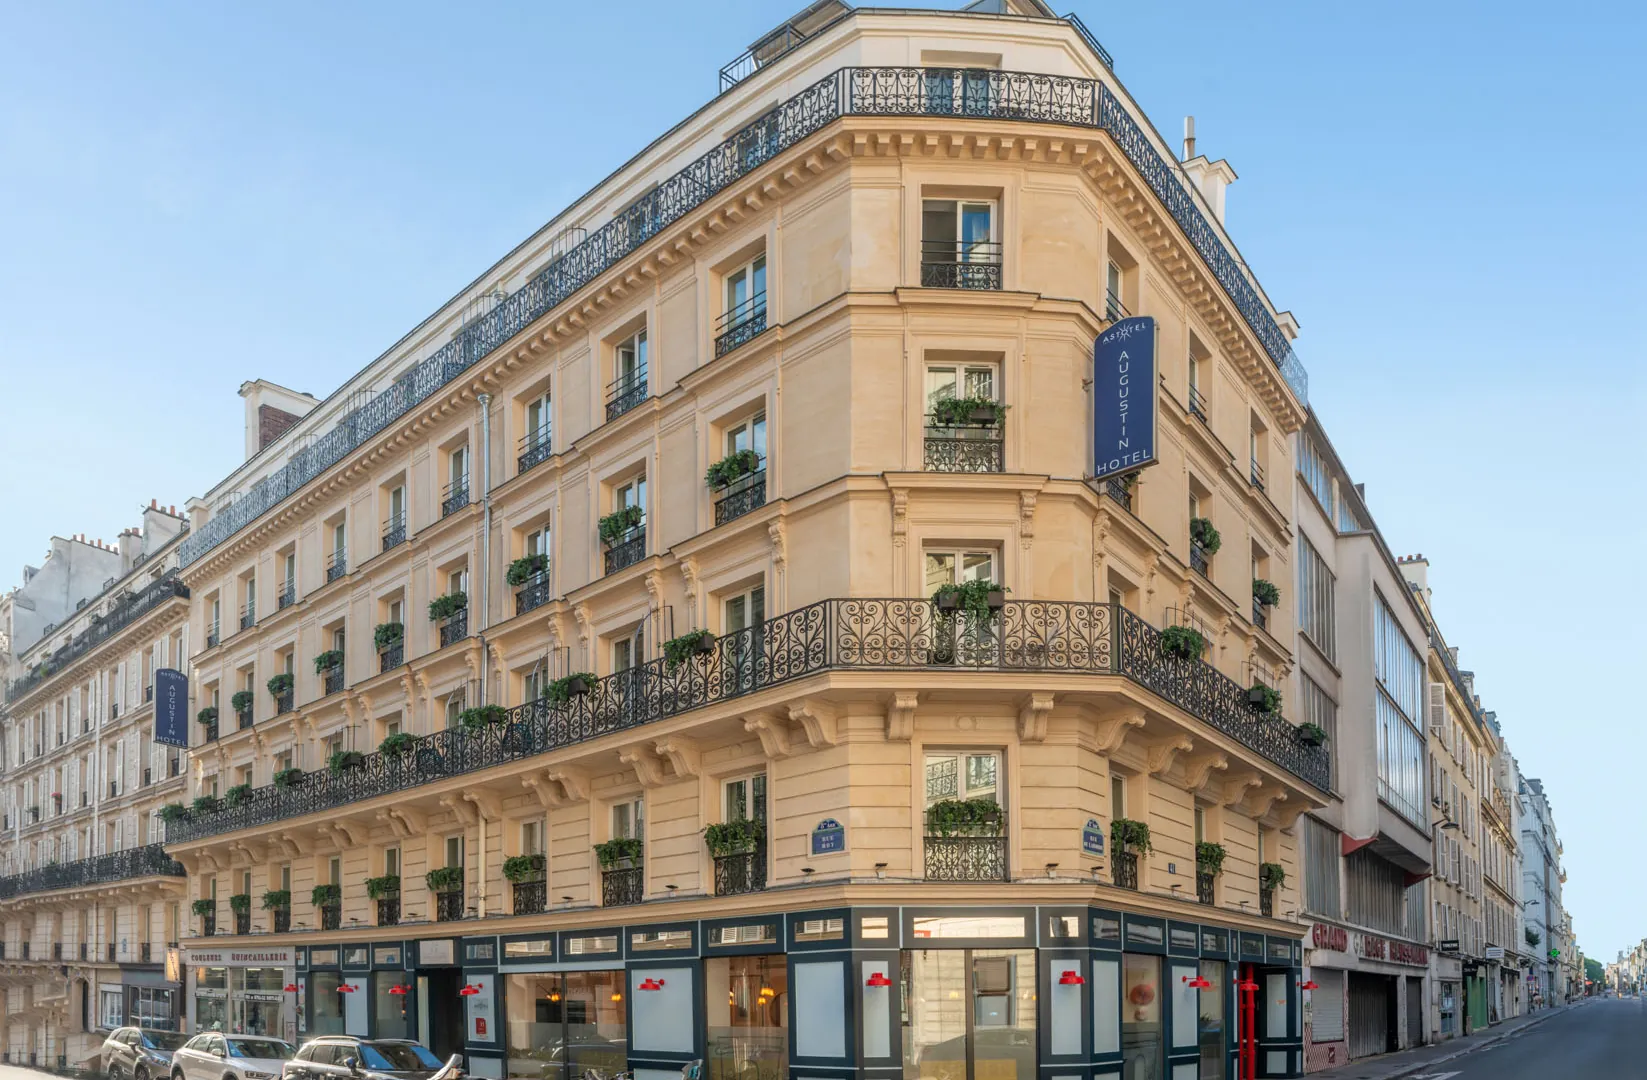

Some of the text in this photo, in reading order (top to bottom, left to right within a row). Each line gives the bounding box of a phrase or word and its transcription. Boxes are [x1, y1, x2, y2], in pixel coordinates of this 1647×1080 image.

[1118, 350, 1130, 450] AUGUSTIN
[1097, 449, 1151, 475] HOTEL
[168, 684, 176, 736] AUGUSTIN
[156, 735, 187, 747] HOTEL
[191, 952, 288, 962] COULEURS QUINCAILLERIE
[1313, 922, 1348, 953] GRAND
[1353, 932, 1386, 960] GARAGE
